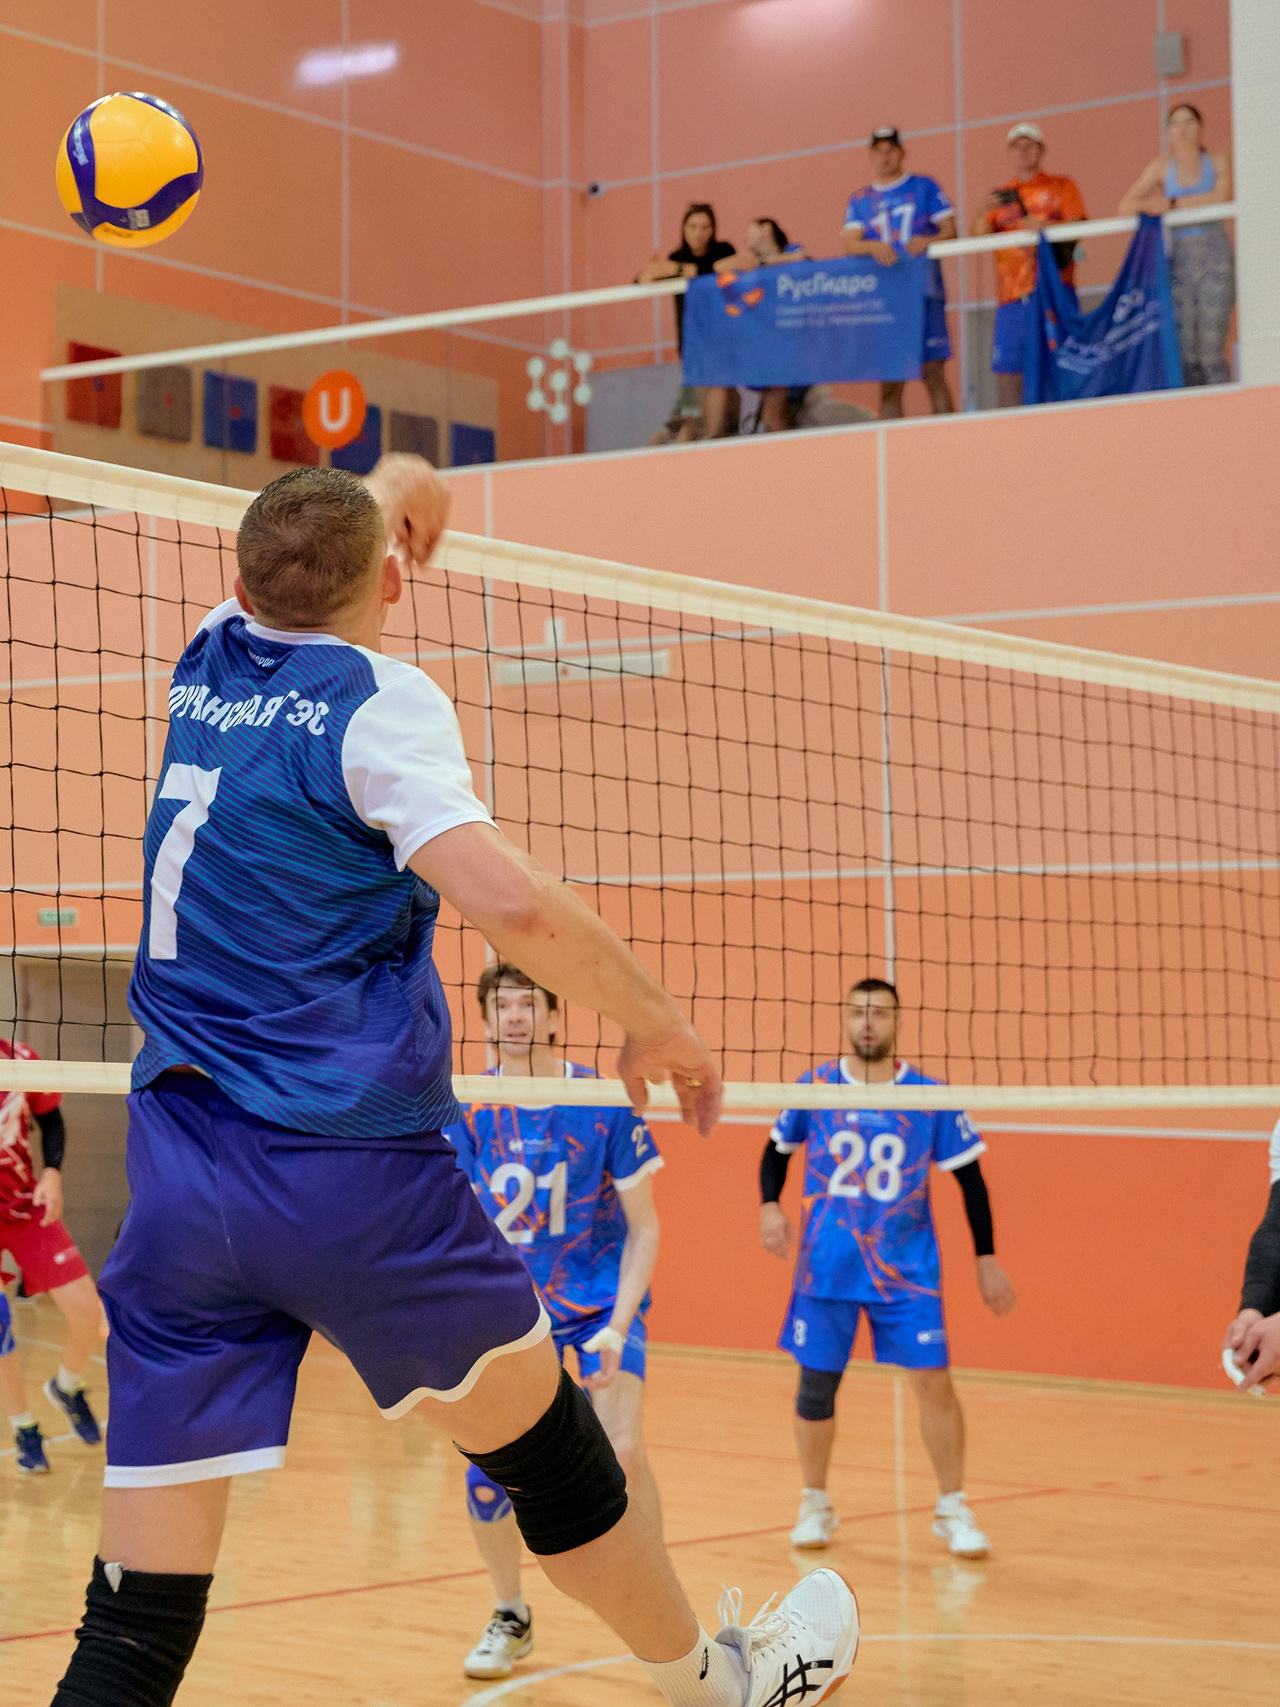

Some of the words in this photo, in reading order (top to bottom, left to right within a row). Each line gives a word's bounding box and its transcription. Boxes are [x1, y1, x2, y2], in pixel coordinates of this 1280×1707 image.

[869, 202, 916, 244] 17
[777, 271, 878, 302] РусГидро
[320, 389, 351, 433] U
[149, 762, 223, 960] 7
[827, 1129, 906, 1203] 28
[490, 1160, 568, 1245] 21
